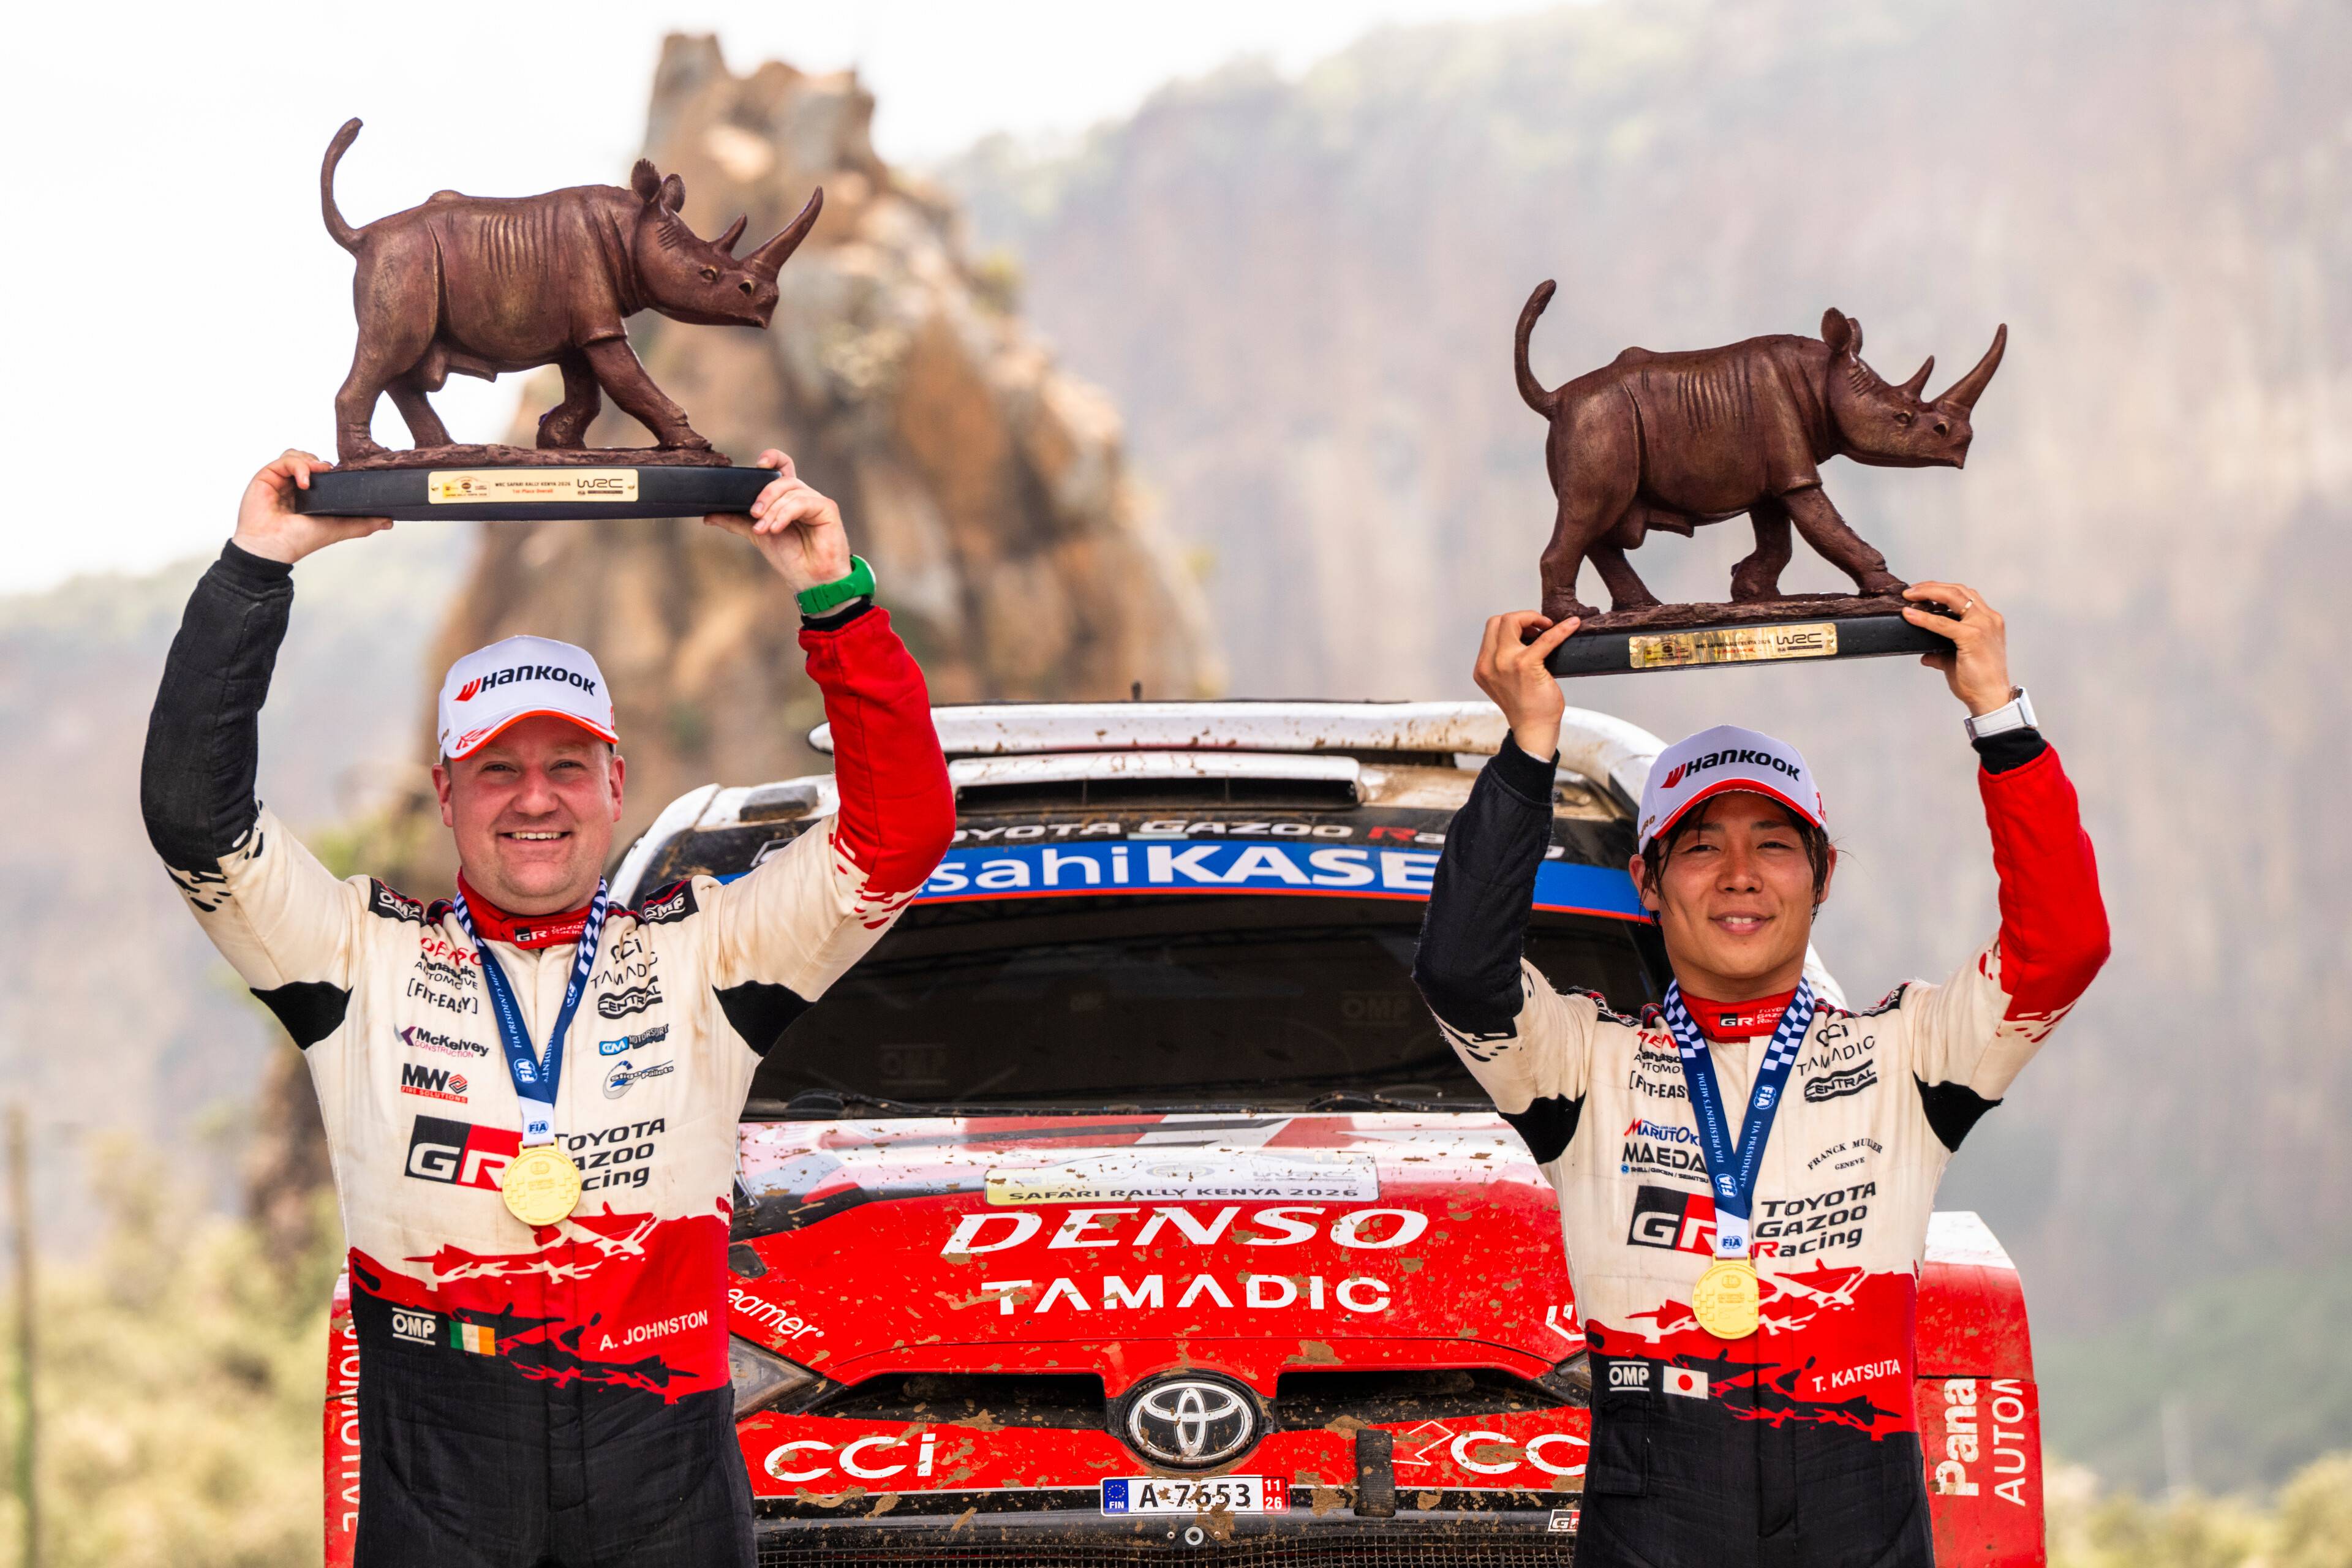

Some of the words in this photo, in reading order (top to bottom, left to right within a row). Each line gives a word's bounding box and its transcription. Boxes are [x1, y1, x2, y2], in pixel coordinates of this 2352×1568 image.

[578, 478, 624, 488] WRC
[1777, 633, 1822, 644] WRC
[951, 823, 1120, 843] YOTA
[1137, 820, 1353, 838] GAZOO
[919, 845, 1441, 892] sahiKASE
[645, 897, 685, 918] OMP
[516, 930, 547, 941] GR
[598, 985, 662, 1012] CENTRAL
[1720, 1017, 1754, 1027] GR
[413, 1040, 474, 1058] CONSTRUCTION
[416, 1027, 489, 1057] McKelvey
[511, 1033, 522, 1048] FIA
[1637, 1030, 1678, 1049] DEN
[1796, 1035, 1875, 1077] TAMADIC
[401, 1063, 450, 1091] MW
[611, 1071, 642, 1082] Sligo
[1697, 1072, 1711, 1098] MEDAL
[1804, 1069, 1877, 1098] CENTRAL
[419, 1089, 467, 1103] SOLUTIONS
[1624, 1117, 1702, 1147] MARUTOK
[1703, 1100, 1722, 1148] PRESIDENT'S
[1752, 1120, 1762, 1134] FIA
[409, 1142, 518, 1189] GR
[571, 1143, 655, 1172] AZOO
[1622, 1142, 1709, 1175] MAEDA
[1716, 1150, 1724, 1163] FIA
[1807, 1142, 1847, 1171] FRANCK
[1834, 1156, 1866, 1171] GENEVE
[582, 1166, 650, 1191] cing
[1009, 1190, 1100, 1200] SAFARI
[1110, 1188, 1188, 1197] RALLY
[1760, 1182, 1877, 1218] TOYOTA
[940, 1207, 1429, 1256] DENSO
[1632, 1211, 1717, 1254] GR
[1755, 1205, 1868, 1238] GAZOO
[1753, 1227, 1863, 1259] Racing
[981, 1273, 1391, 1315] TAMADIC
[393, 1313, 436, 1338] OMP
[599, 1333, 618, 1352] A.
[622, 1309, 709, 1346] JOHNSTON
[1608, 1366, 1649, 1386] OMP
[1812, 1376, 1827, 1393] T.
[1831, 1359, 1901, 1389] KATSUTA
[1264, 1480, 1281, 1491] 11
[1265, 1496, 1283, 1510] 26
